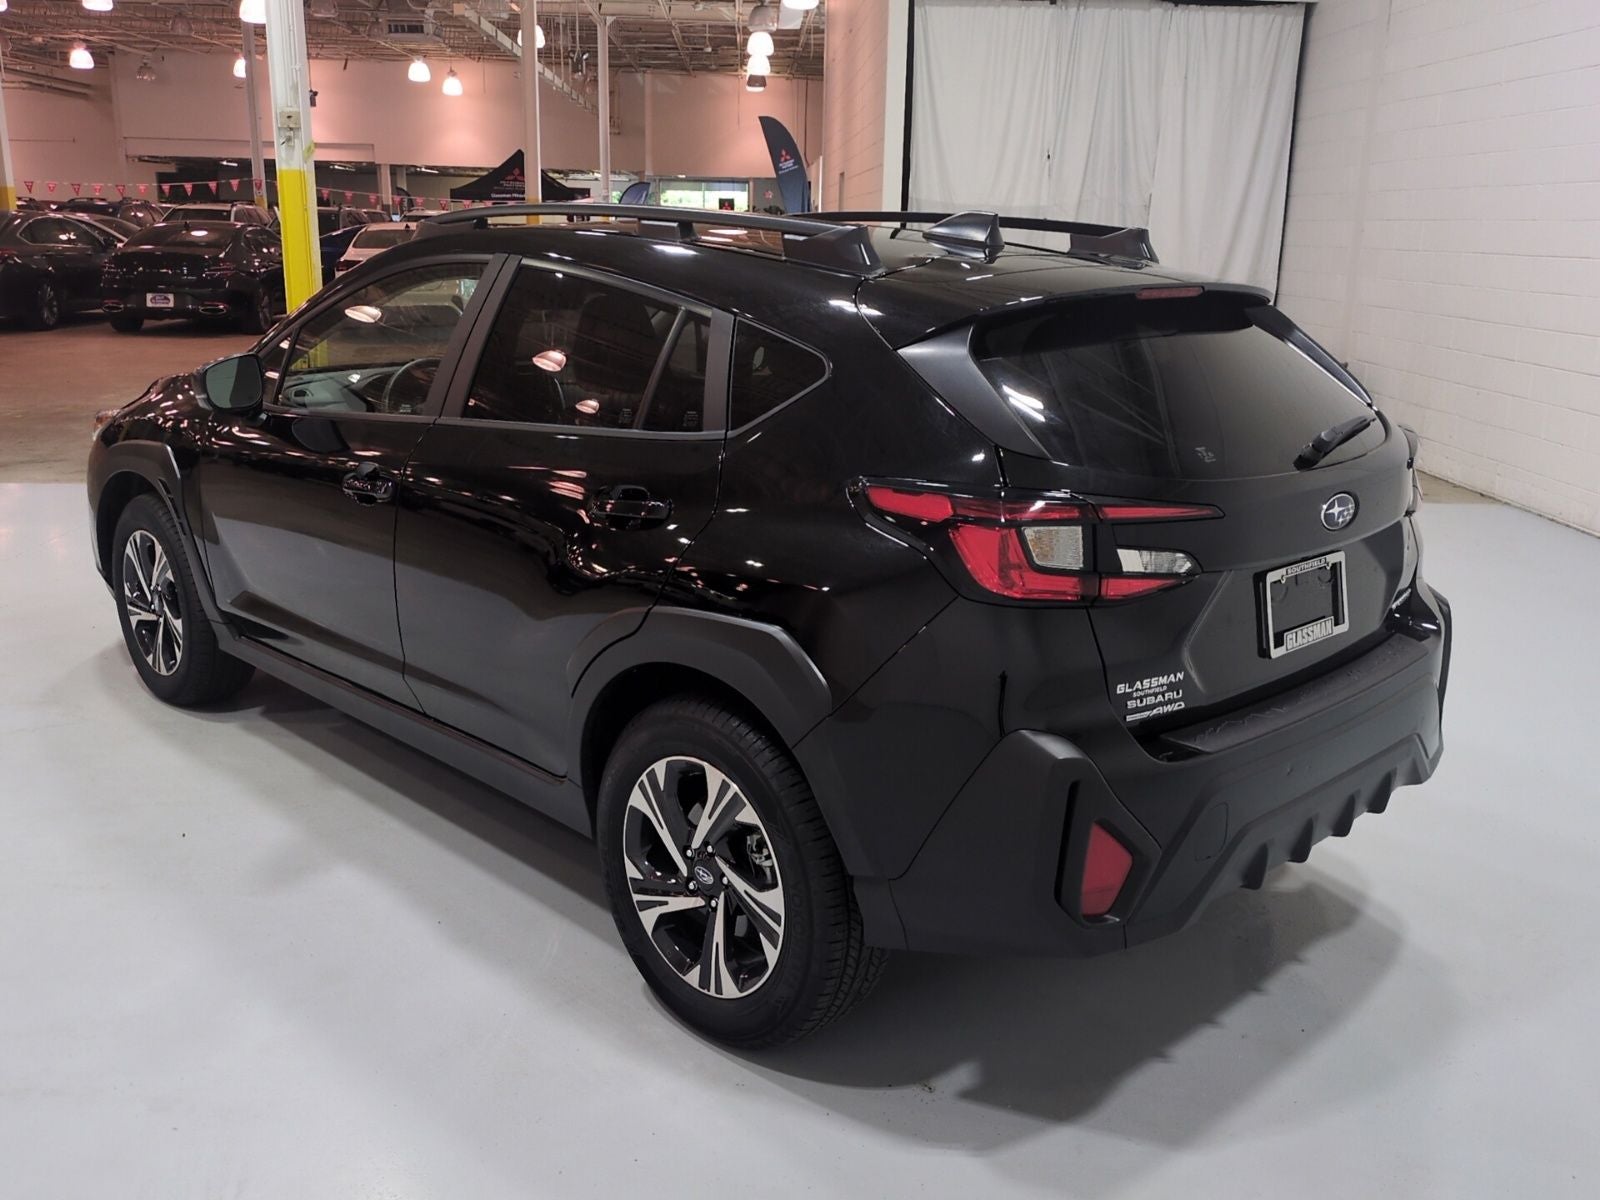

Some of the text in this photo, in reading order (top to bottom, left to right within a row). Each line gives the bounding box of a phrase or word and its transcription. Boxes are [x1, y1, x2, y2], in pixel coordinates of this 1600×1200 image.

[1287, 558, 1325, 574] SOUTHFIELD
[1286, 619, 1332, 650] GLASSMAN
[1117, 671, 1184, 694] GLASSMAN
[1133, 685, 1168, 698] SOUTHFIELD
[1127, 689, 1182, 709] SUBARU
[1150, 701, 1185, 717] AWD
